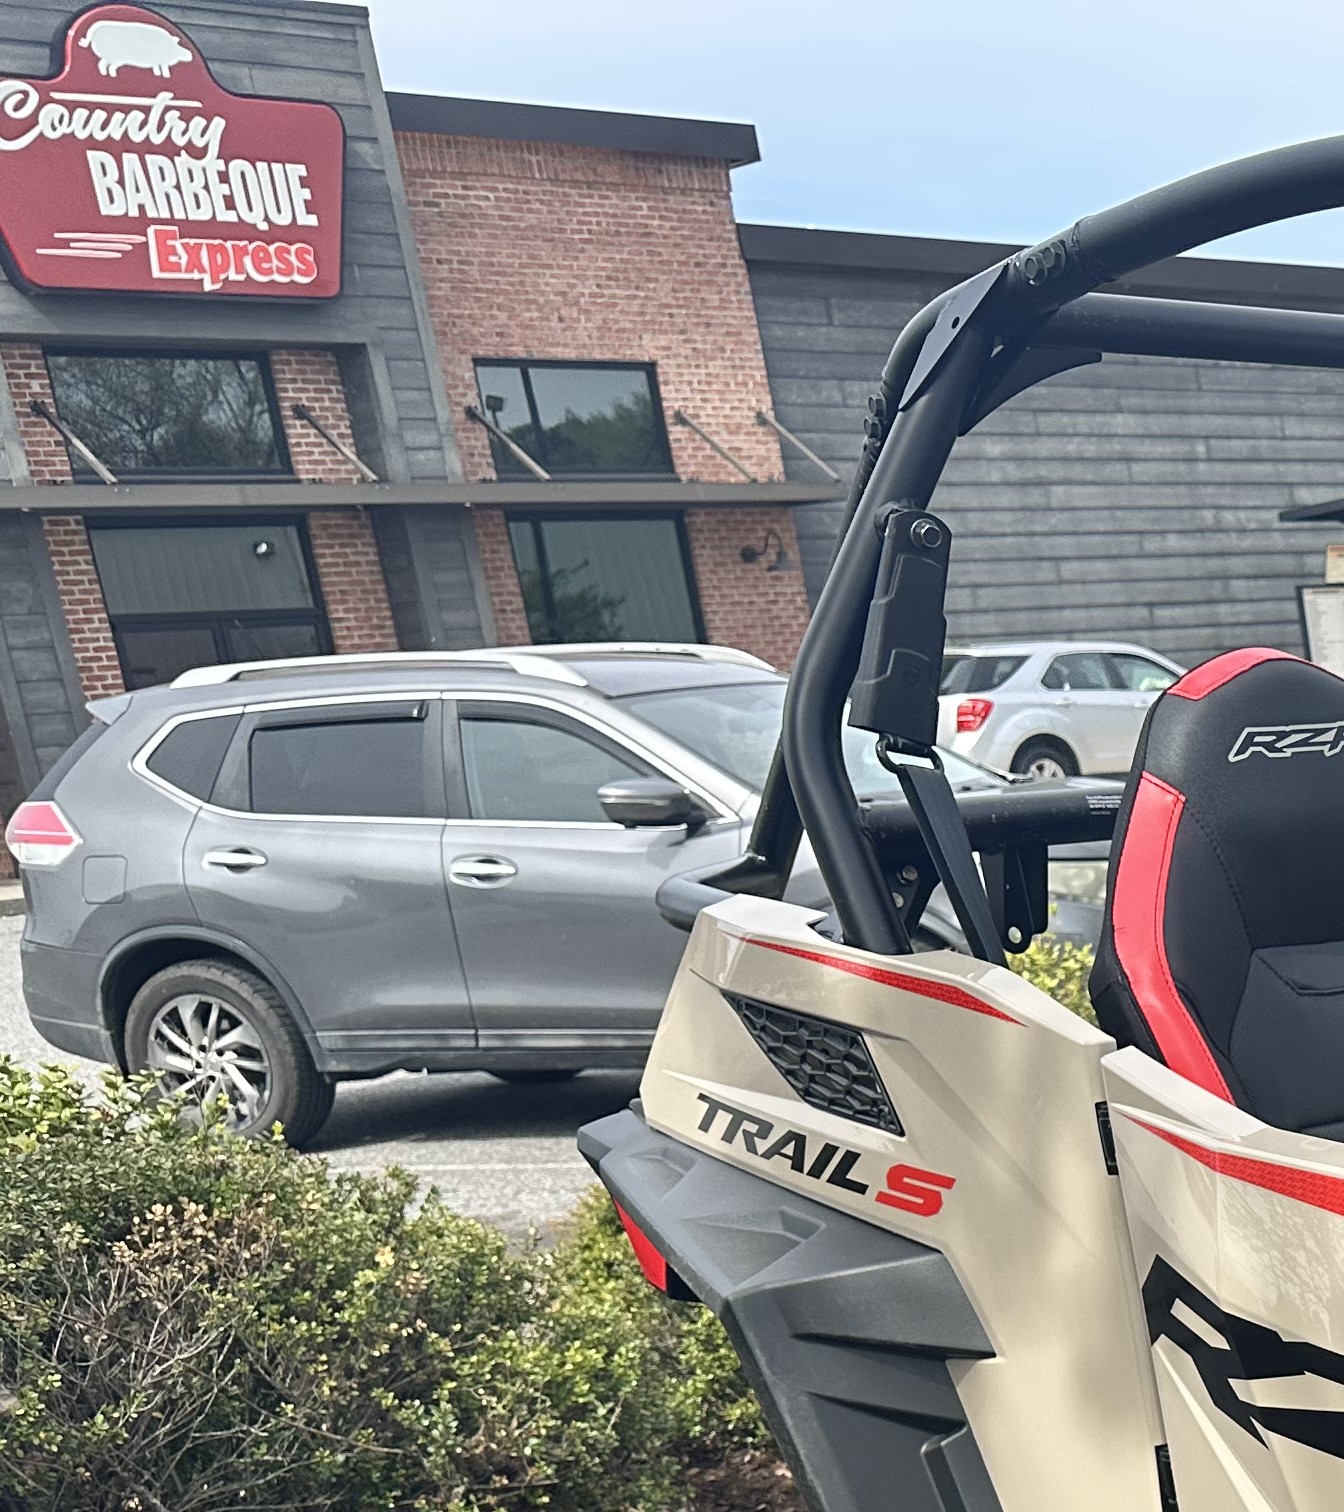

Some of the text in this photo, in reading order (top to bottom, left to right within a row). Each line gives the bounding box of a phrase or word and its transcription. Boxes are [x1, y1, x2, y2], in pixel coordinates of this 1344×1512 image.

[0, 80, 226, 162] Country
[86, 149, 319, 231] BARBEQUE
[146, 224, 318, 292] Express
[697, 1092, 957, 1218] TRAIL S
